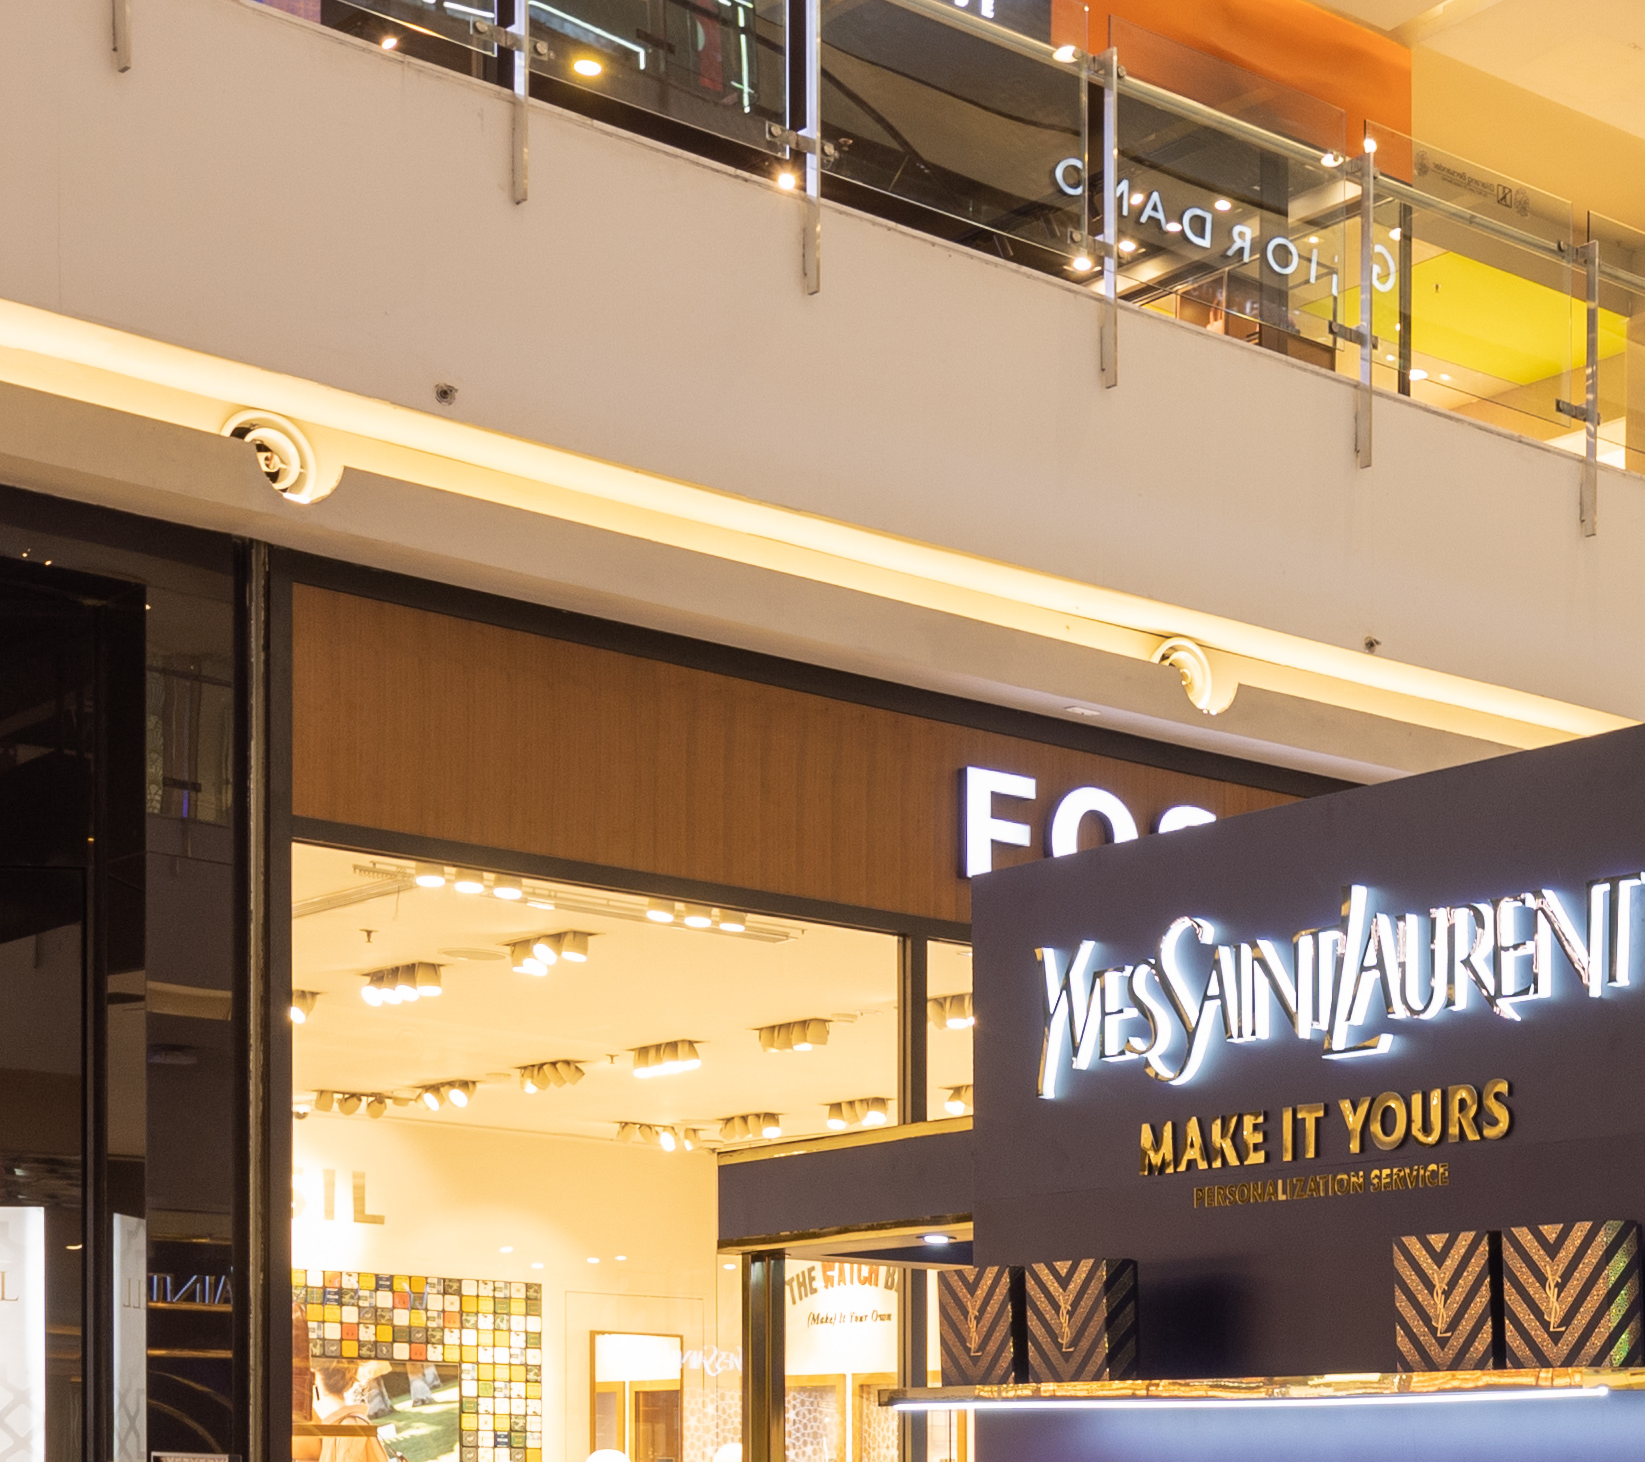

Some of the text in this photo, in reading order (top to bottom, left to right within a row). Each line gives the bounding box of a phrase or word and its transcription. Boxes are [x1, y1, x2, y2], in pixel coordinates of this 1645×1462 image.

[1140, 1078, 1513, 1176] MAKE IT YOURS
[1193, 1162, 1449, 1208] PERSONALIZATION SERVICE
[785, 1265, 819, 1305] THE
[871, 1309, 892, 1322] Own
